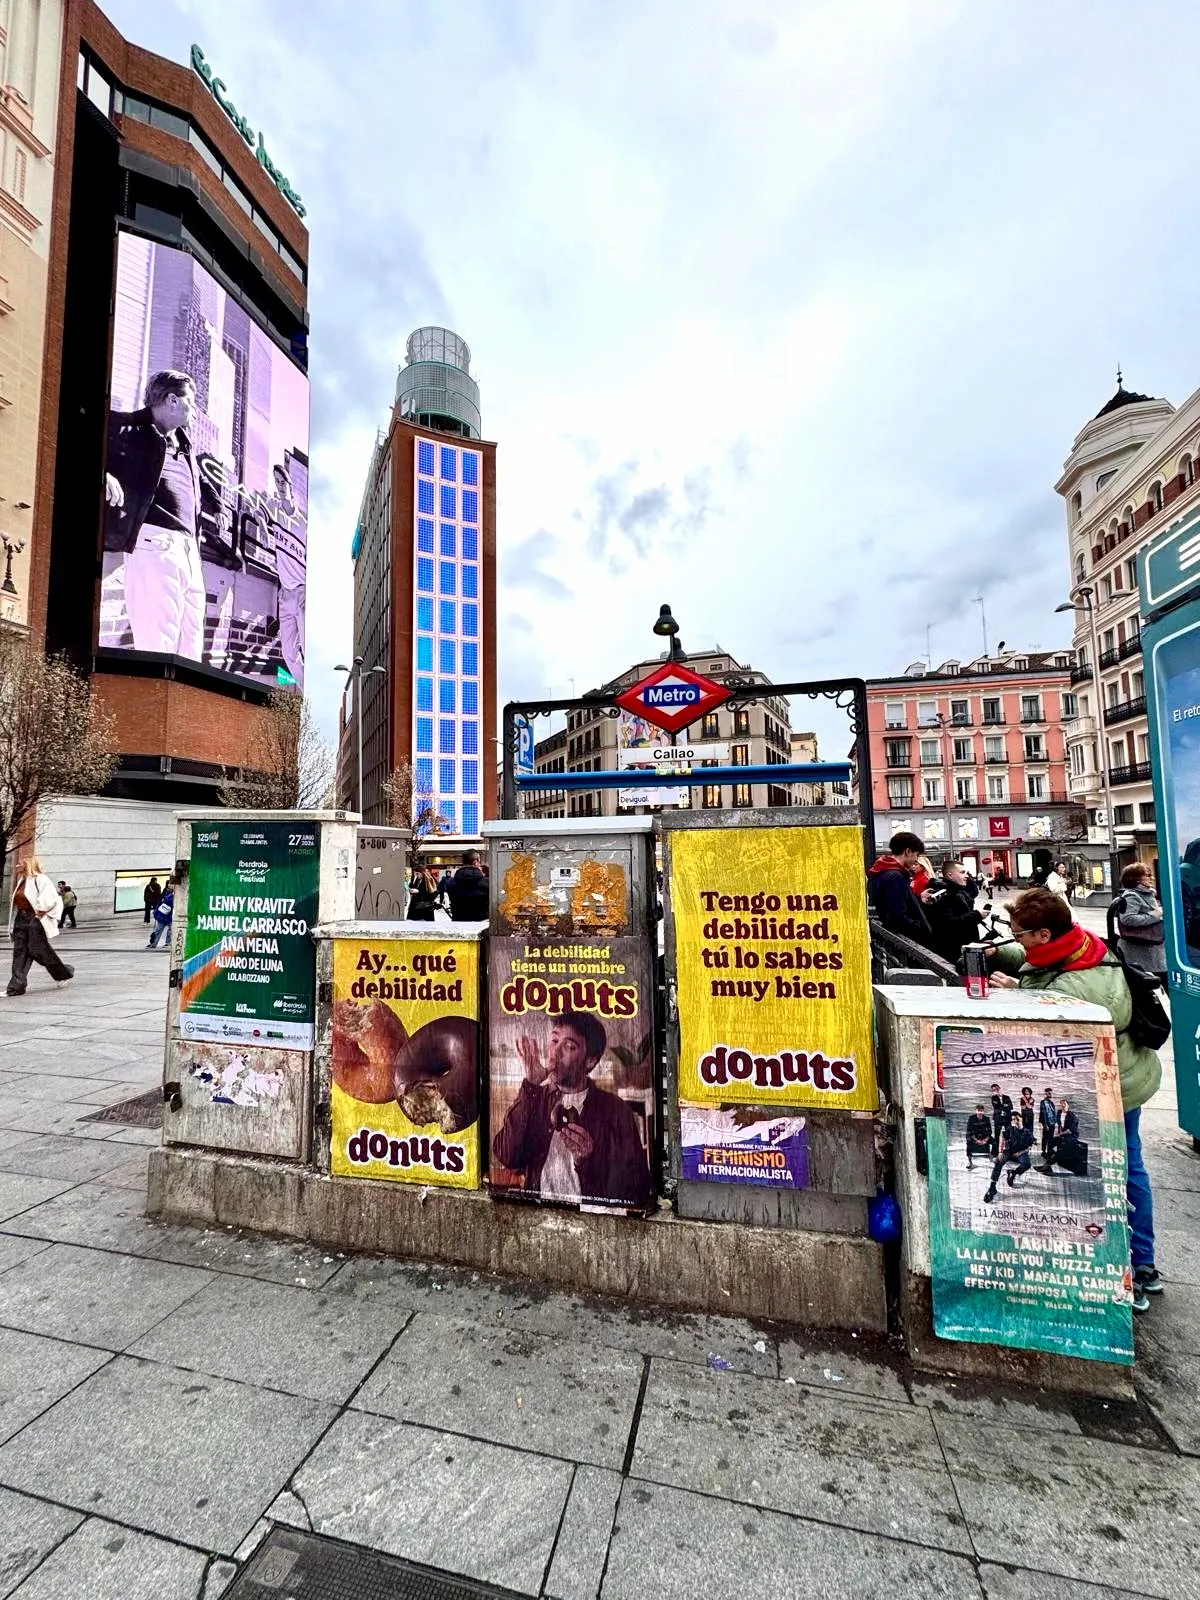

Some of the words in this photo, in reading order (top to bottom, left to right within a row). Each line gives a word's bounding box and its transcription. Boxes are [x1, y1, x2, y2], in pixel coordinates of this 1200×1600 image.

[648, 688, 696, 703] Metro
[1173, 709, 1182, 722] El
[653, 748, 695, 760] Callao
[288, 834, 302, 846] 27
[238, 860, 268, 868] Iberdrola
[209, 895, 246, 912] LENNY
[247, 897, 295, 915] KRAVITZ
[700, 891, 781, 916] Tengo
[787, 893, 839, 912] una
[197, 915, 240, 932] MANUEL
[242, 917, 307, 936] CARRASCO
[703, 917, 839, 944] debilidad,
[220, 935, 245, 952] ANA
[246, 938, 279, 955] MENA
[524, 945, 541, 958] La
[543, 945, 611, 959] debilidad
[248, 959, 260, 971] DE
[261, 959, 284, 972] LUNA
[356, 949, 407, 975] Ay...
[412, 949, 457, 977] qué
[511, 960, 546, 974] tiene
[549, 962, 567, 974] un
[569, 961, 626, 975] nombre
[701, 945, 729, 968] tú
[735, 946, 760, 968] lo
[764, 946, 843, 970] sabes
[227, 972, 242, 981] LOLA
[242, 974, 270, 984] BOZZANO
[351, 976, 463, 1002] debilidad
[502, 977, 636, 1016] donuts
[711, 978, 770, 1002] muy
[775, 976, 837, 999] bien
[961, 1042, 1091, 1065] COMANDANTE
[1040, 1056, 1076, 1071] TWIN
[700, 1046, 855, 1091] donuts
[348, 1129, 464, 1173] donuts
[704, 1148, 786, 1168] FEMINISMO
[698, 1163, 793, 1181] INTERNACIONALISTA
[978, 1208, 988, 1218] 11
[990, 1209, 1016, 1221] ABRIL
[1023, 1212, 1049, 1224] SALA
[1051, 1215, 1078, 1227] MON
[1013, 1236, 1096, 1258] TABURETE
[957, 1247, 972, 1260] LA
[973, 1249, 989, 1261] LA
[991, 1250, 1019, 1265] LOVE
[1020, 1253, 1044, 1268] YOU
[1052, 1257, 1093, 1273] FUZZZ
[964, 1276, 1006, 1291] EFECTO
[1008, 1282, 1068, 1299] MARIPOSA
[970, 1263, 992, 1277] HEY
[995, 1266, 1015, 1279] KID
[1023, 1269, 1079, 1287] MAFALDA
[1081, 1276, 1124, 1292] CARDE
